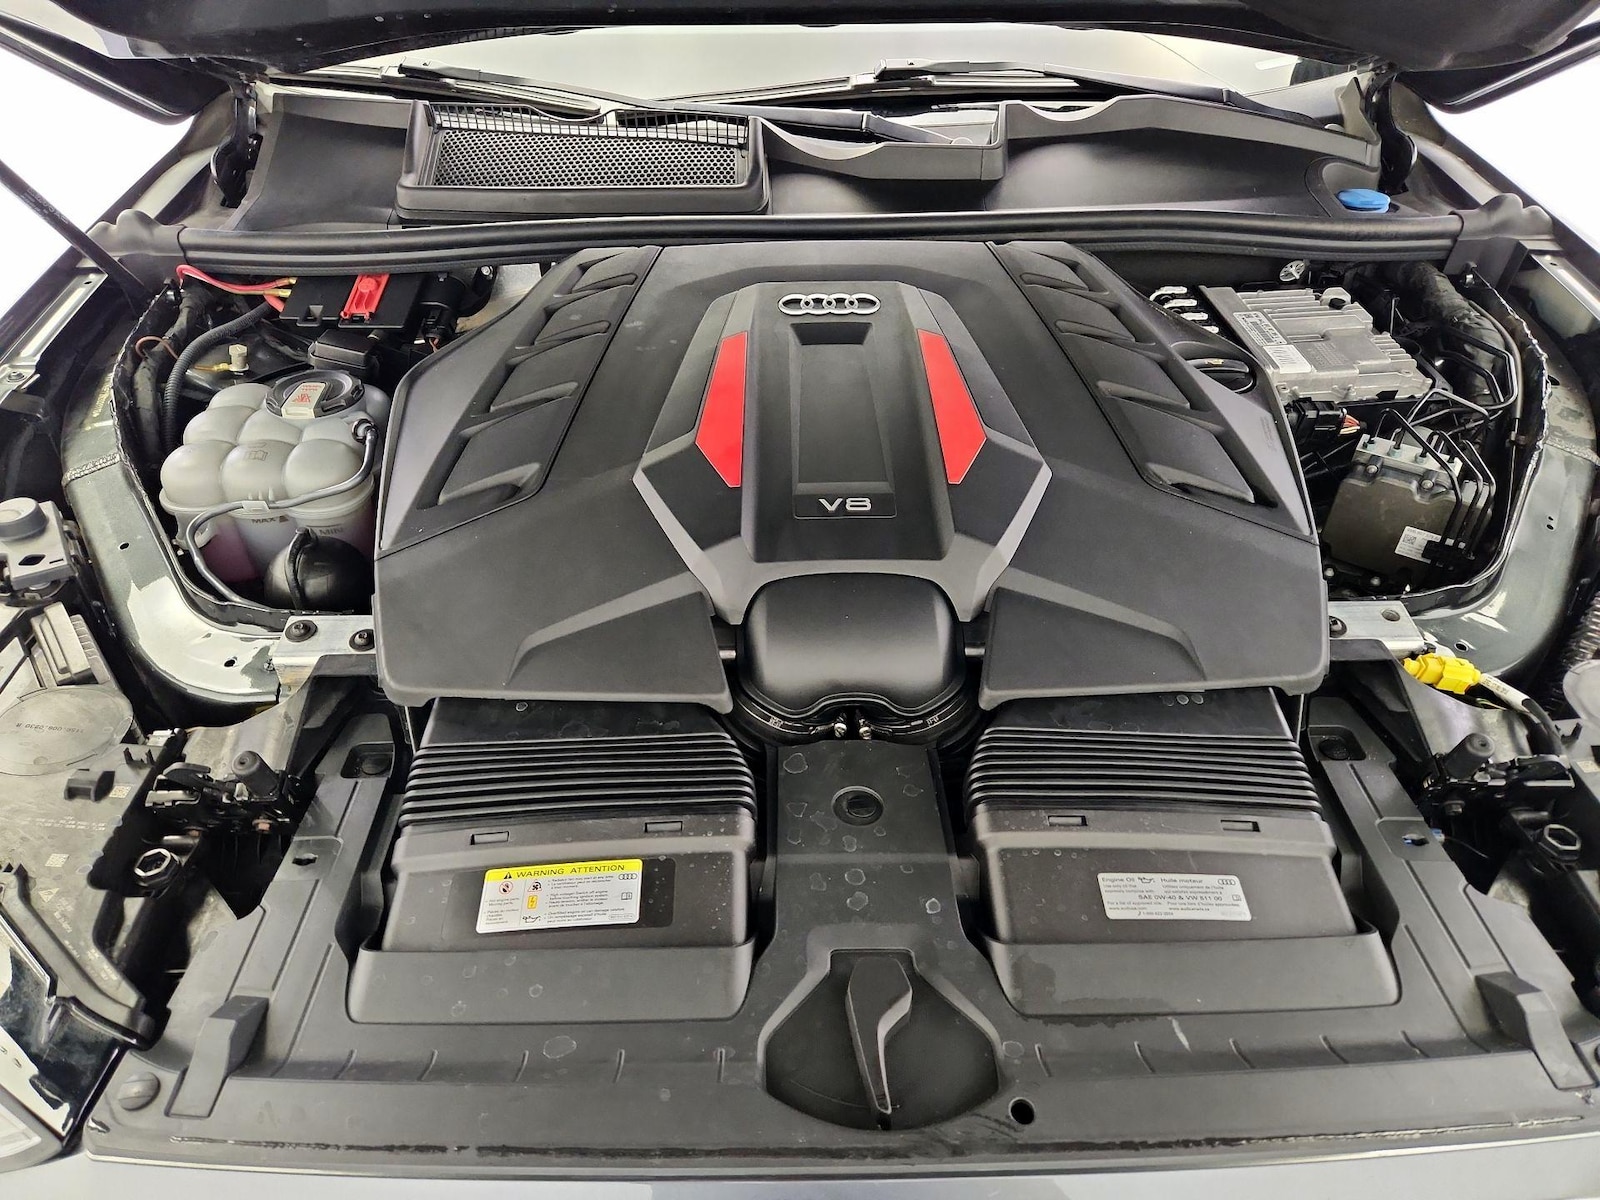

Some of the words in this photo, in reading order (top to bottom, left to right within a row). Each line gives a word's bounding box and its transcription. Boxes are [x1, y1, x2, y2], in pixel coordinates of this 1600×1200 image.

[818, 497, 872, 512] V8
[516, 868, 564, 878] WARNING
[569, 865, 625, 874] ATTENTION
